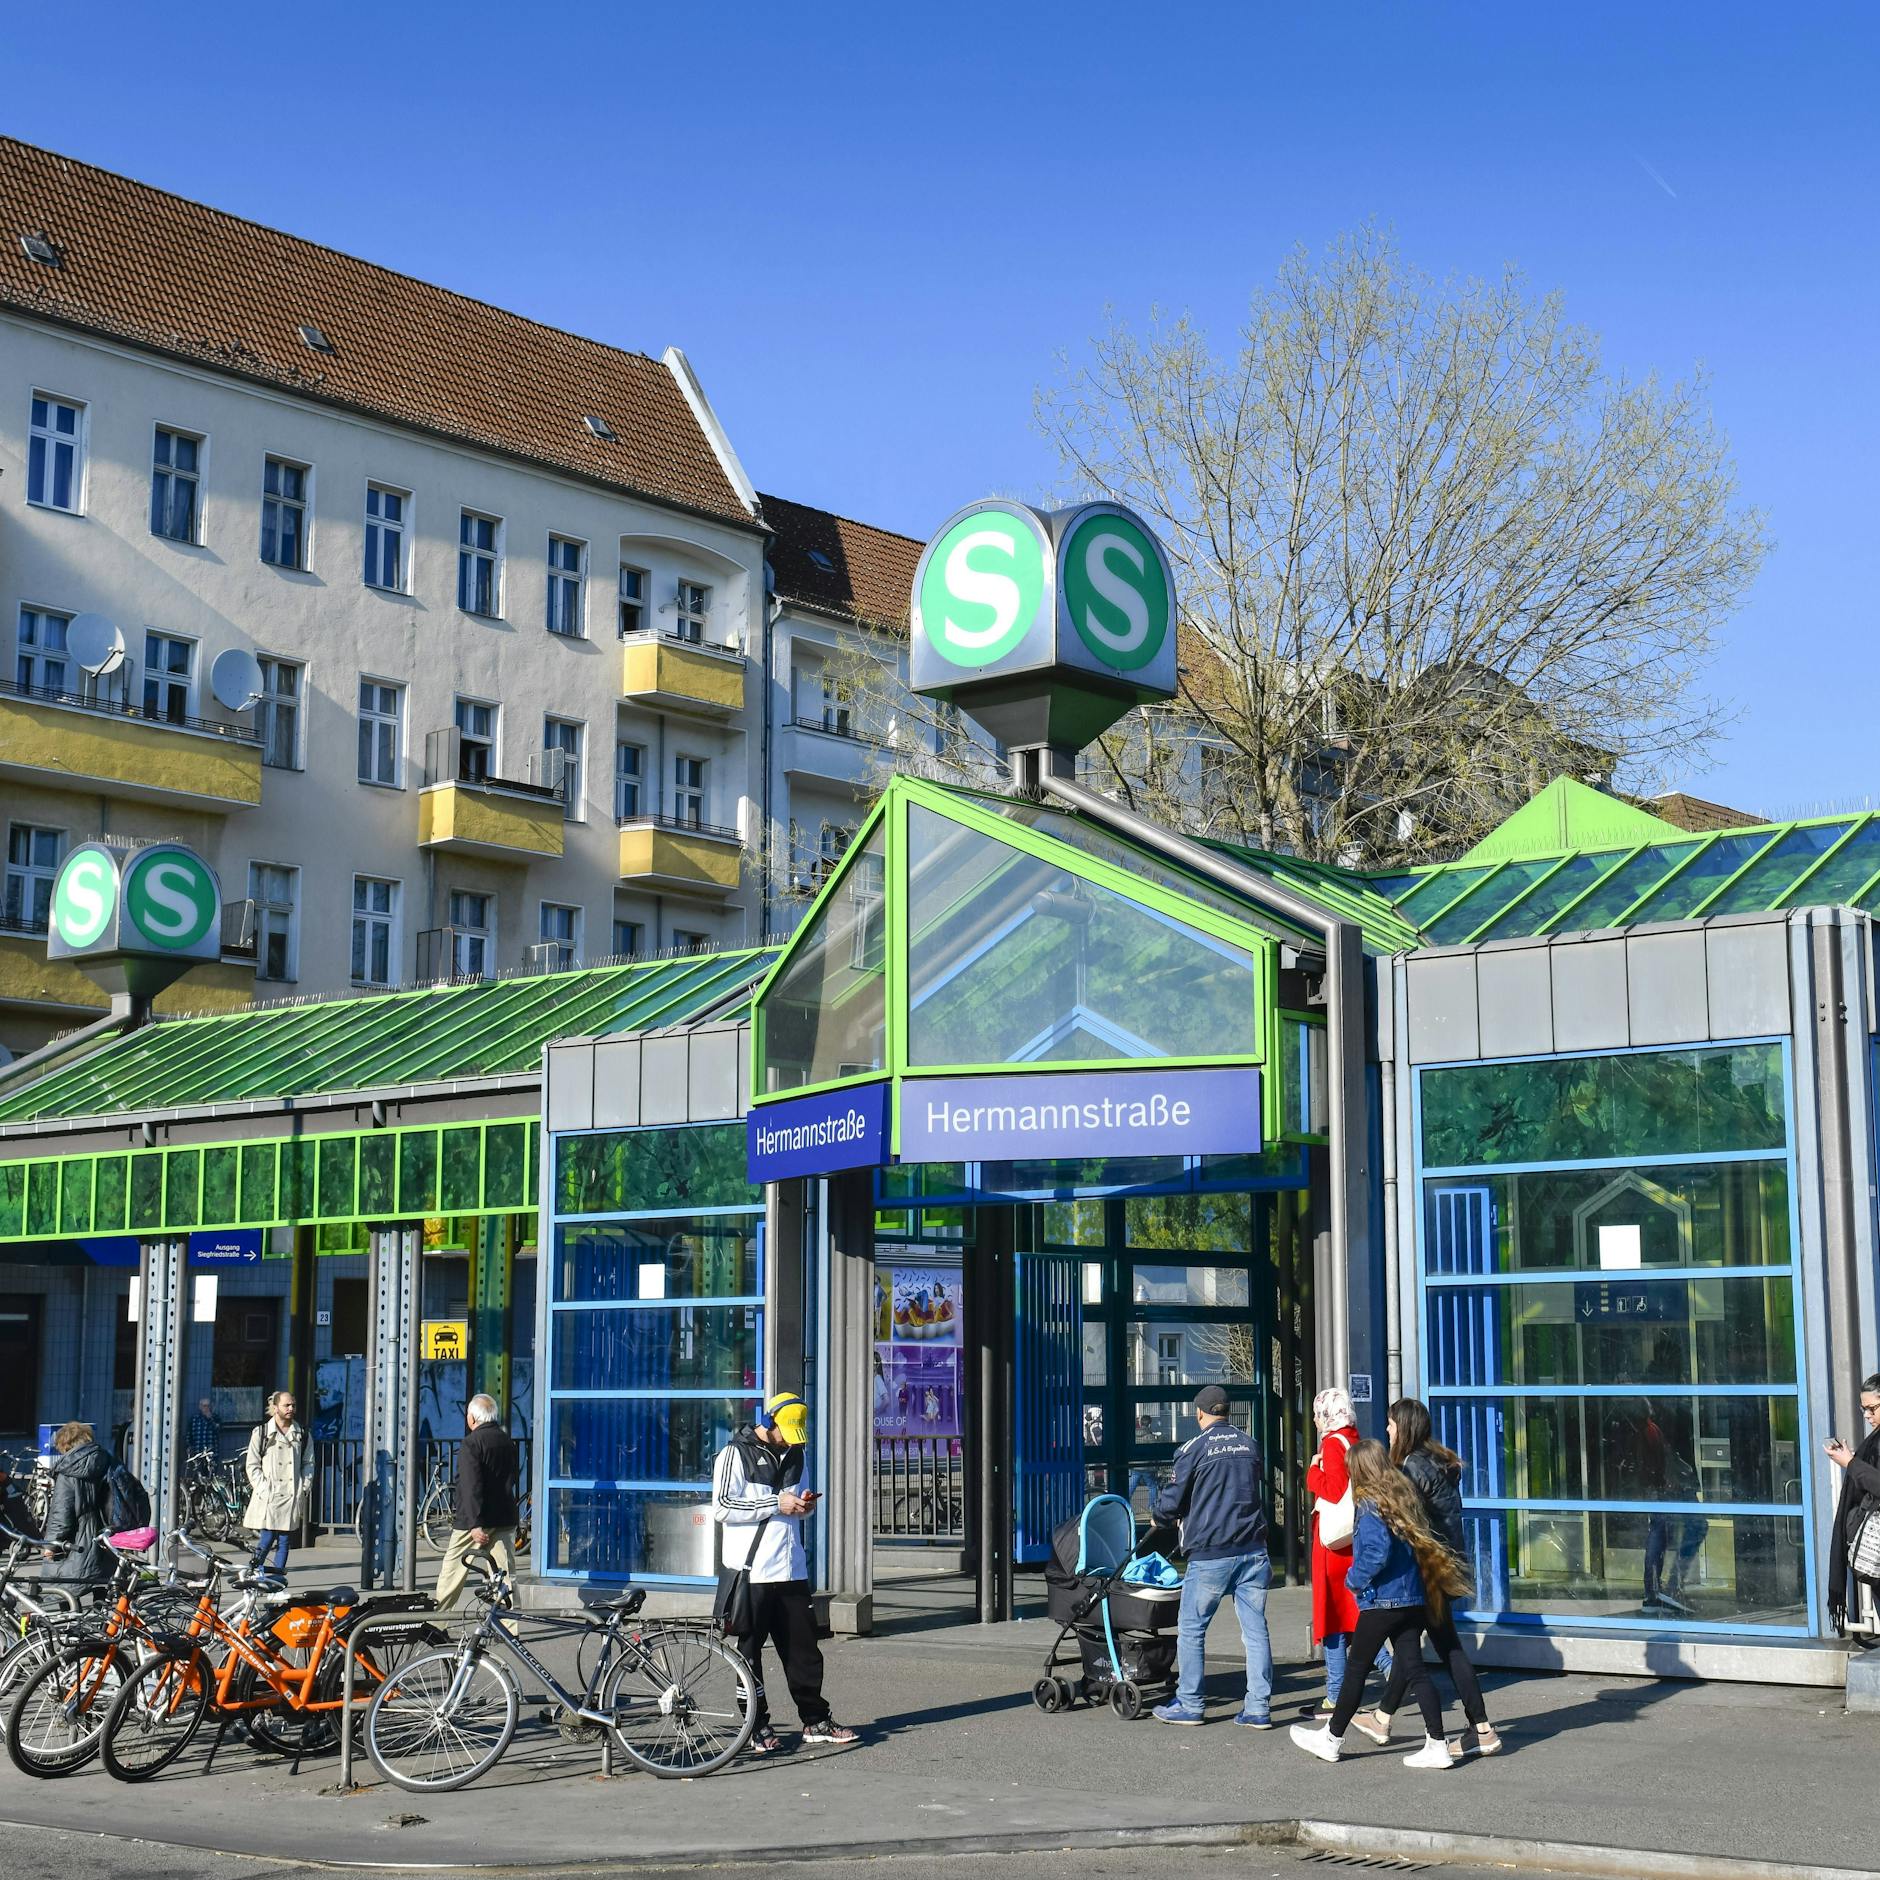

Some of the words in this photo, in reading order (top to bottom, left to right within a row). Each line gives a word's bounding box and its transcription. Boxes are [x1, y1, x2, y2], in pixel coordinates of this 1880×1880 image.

[945, 531, 1020, 648] S
[1086, 533, 1149, 652] S
[65, 862, 103, 936] S
[144, 863, 198, 937] S
[755, 1108, 866, 1156] Hermannstraße
[926, 1094, 1192, 1134] Hermannstraße
[197, 1251, 240, 1259] Siegfriedstraße
[215, 1244, 241, 1252] Ausgang
[319, 1313, 330, 1322] 23
[434, 1347, 459, 1360] TAXI
[873, 1417, 894, 1427] OUSE
[895, 1416, 907, 1426] OF
[511, 1638, 554, 1683] PEUGEOT
